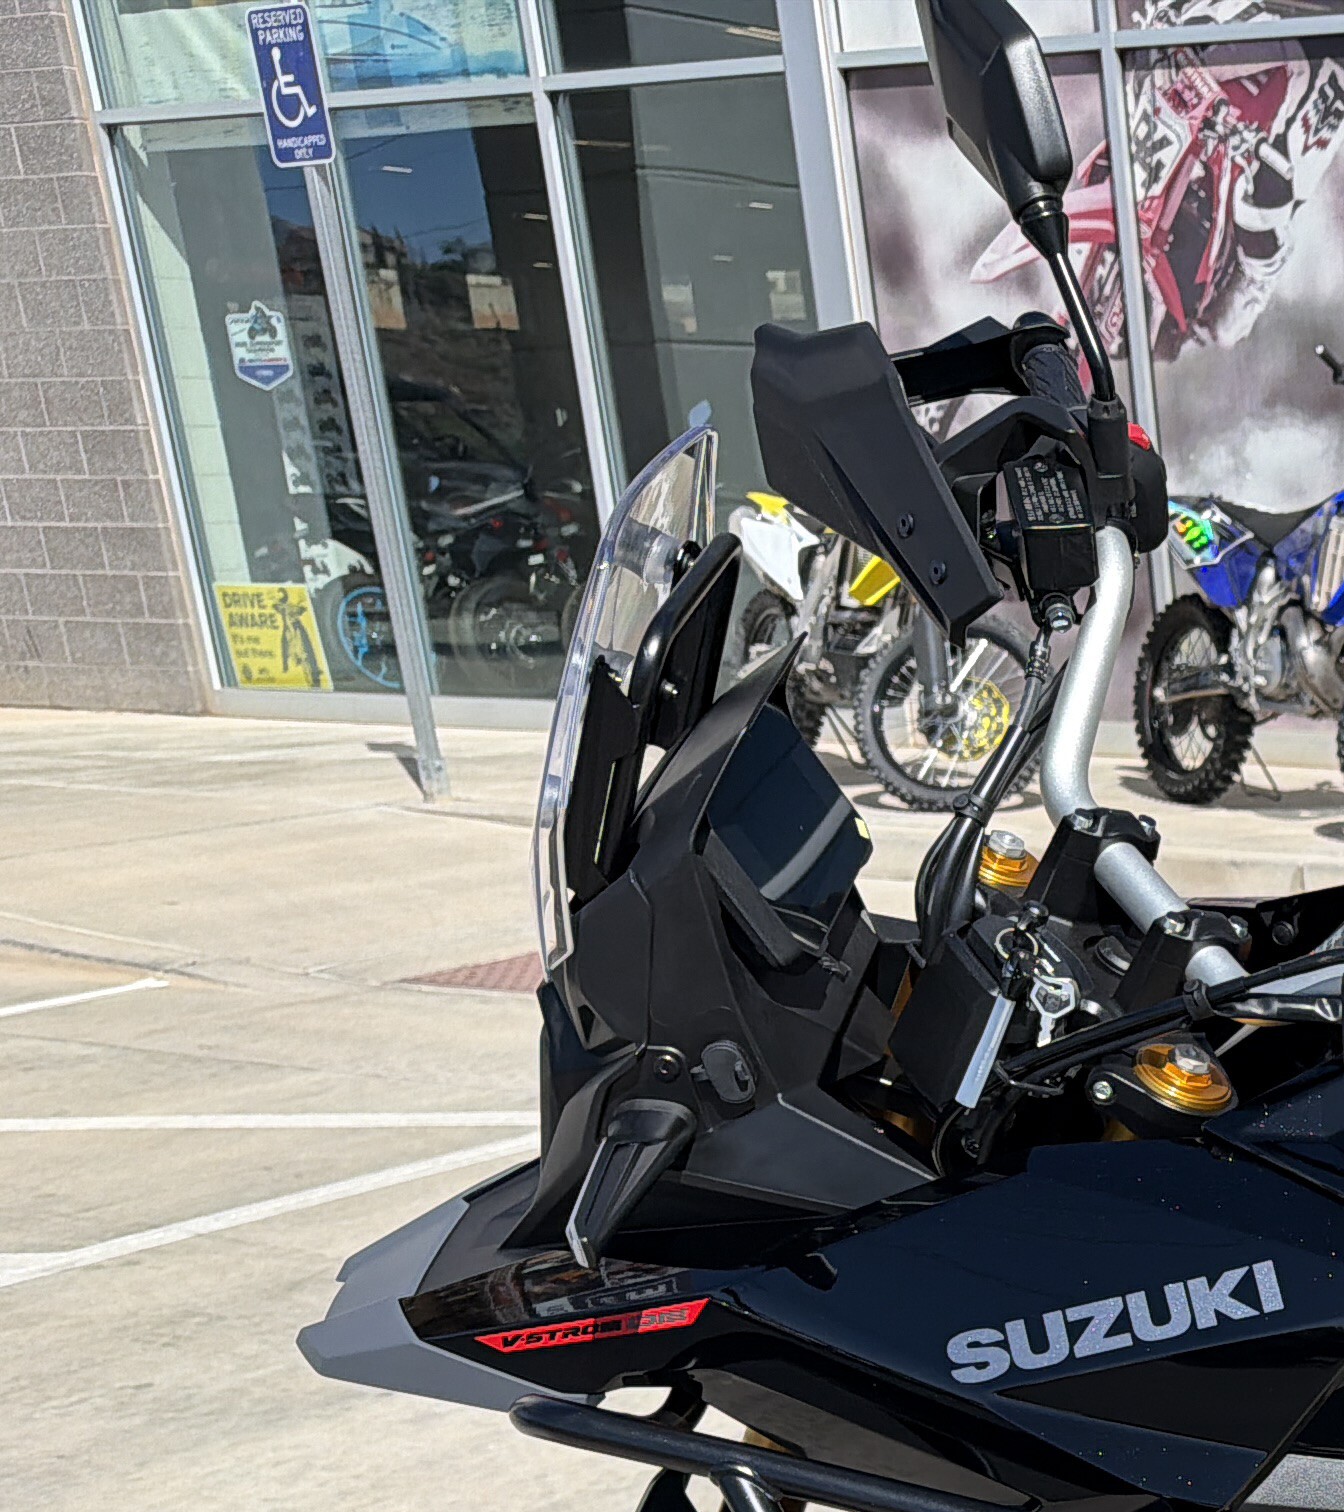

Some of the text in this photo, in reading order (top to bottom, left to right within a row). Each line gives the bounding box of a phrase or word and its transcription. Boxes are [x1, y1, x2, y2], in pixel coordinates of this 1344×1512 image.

[250, 8, 305, 29] RESERVED
[257, 26, 305, 45] PARKING
[276, 134, 327, 148] HANDICAPPED
[221, 591, 268, 610] DRIVE
[228, 611, 280, 630] AWARE
[946, 1259, 1285, 1384] SUZUKI
[501, 1318, 623, 1350] V-STROM
